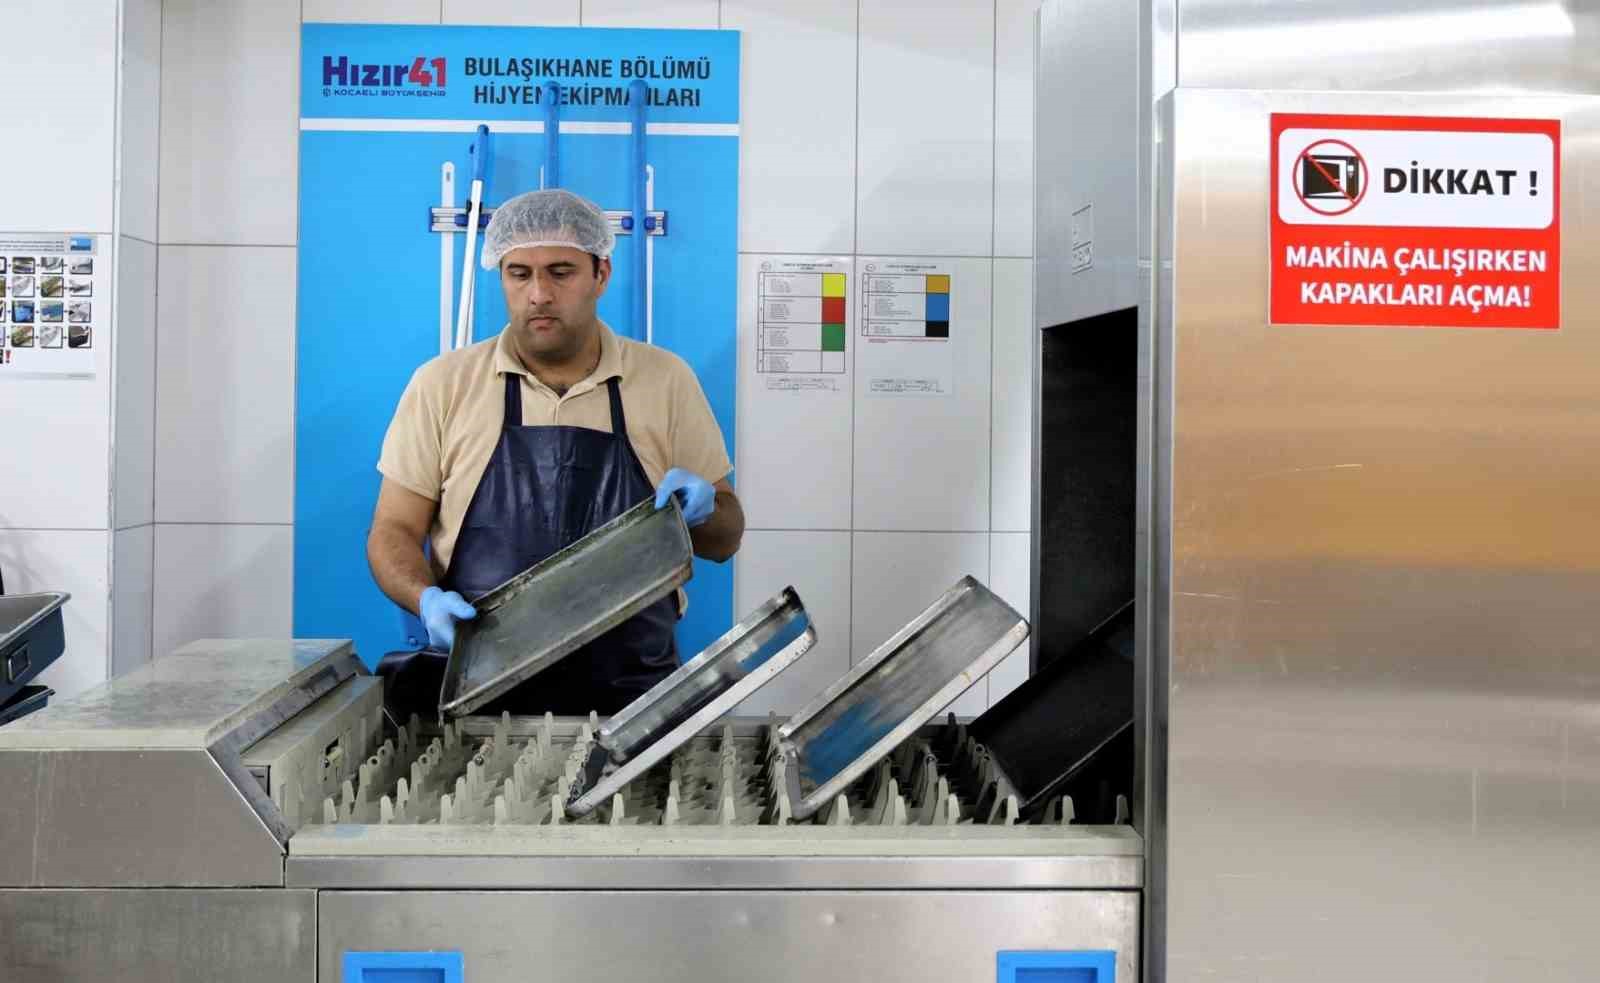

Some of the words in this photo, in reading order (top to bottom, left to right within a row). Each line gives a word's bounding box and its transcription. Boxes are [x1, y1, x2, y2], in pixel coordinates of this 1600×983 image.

[465, 57, 613, 82] BULAŞIKHANE
[620, 56, 710, 80] BÖLÜMÜ
[1383, 160, 1517, 196] DİKKAT
[1286, 241, 1388, 269] MAKİNA
[1393, 247, 1547, 277] ÇALIŞIRKEN
[1301, 282, 1443, 306] KAPAKLARI
[1449, 284, 1531, 313] AÇMA!
